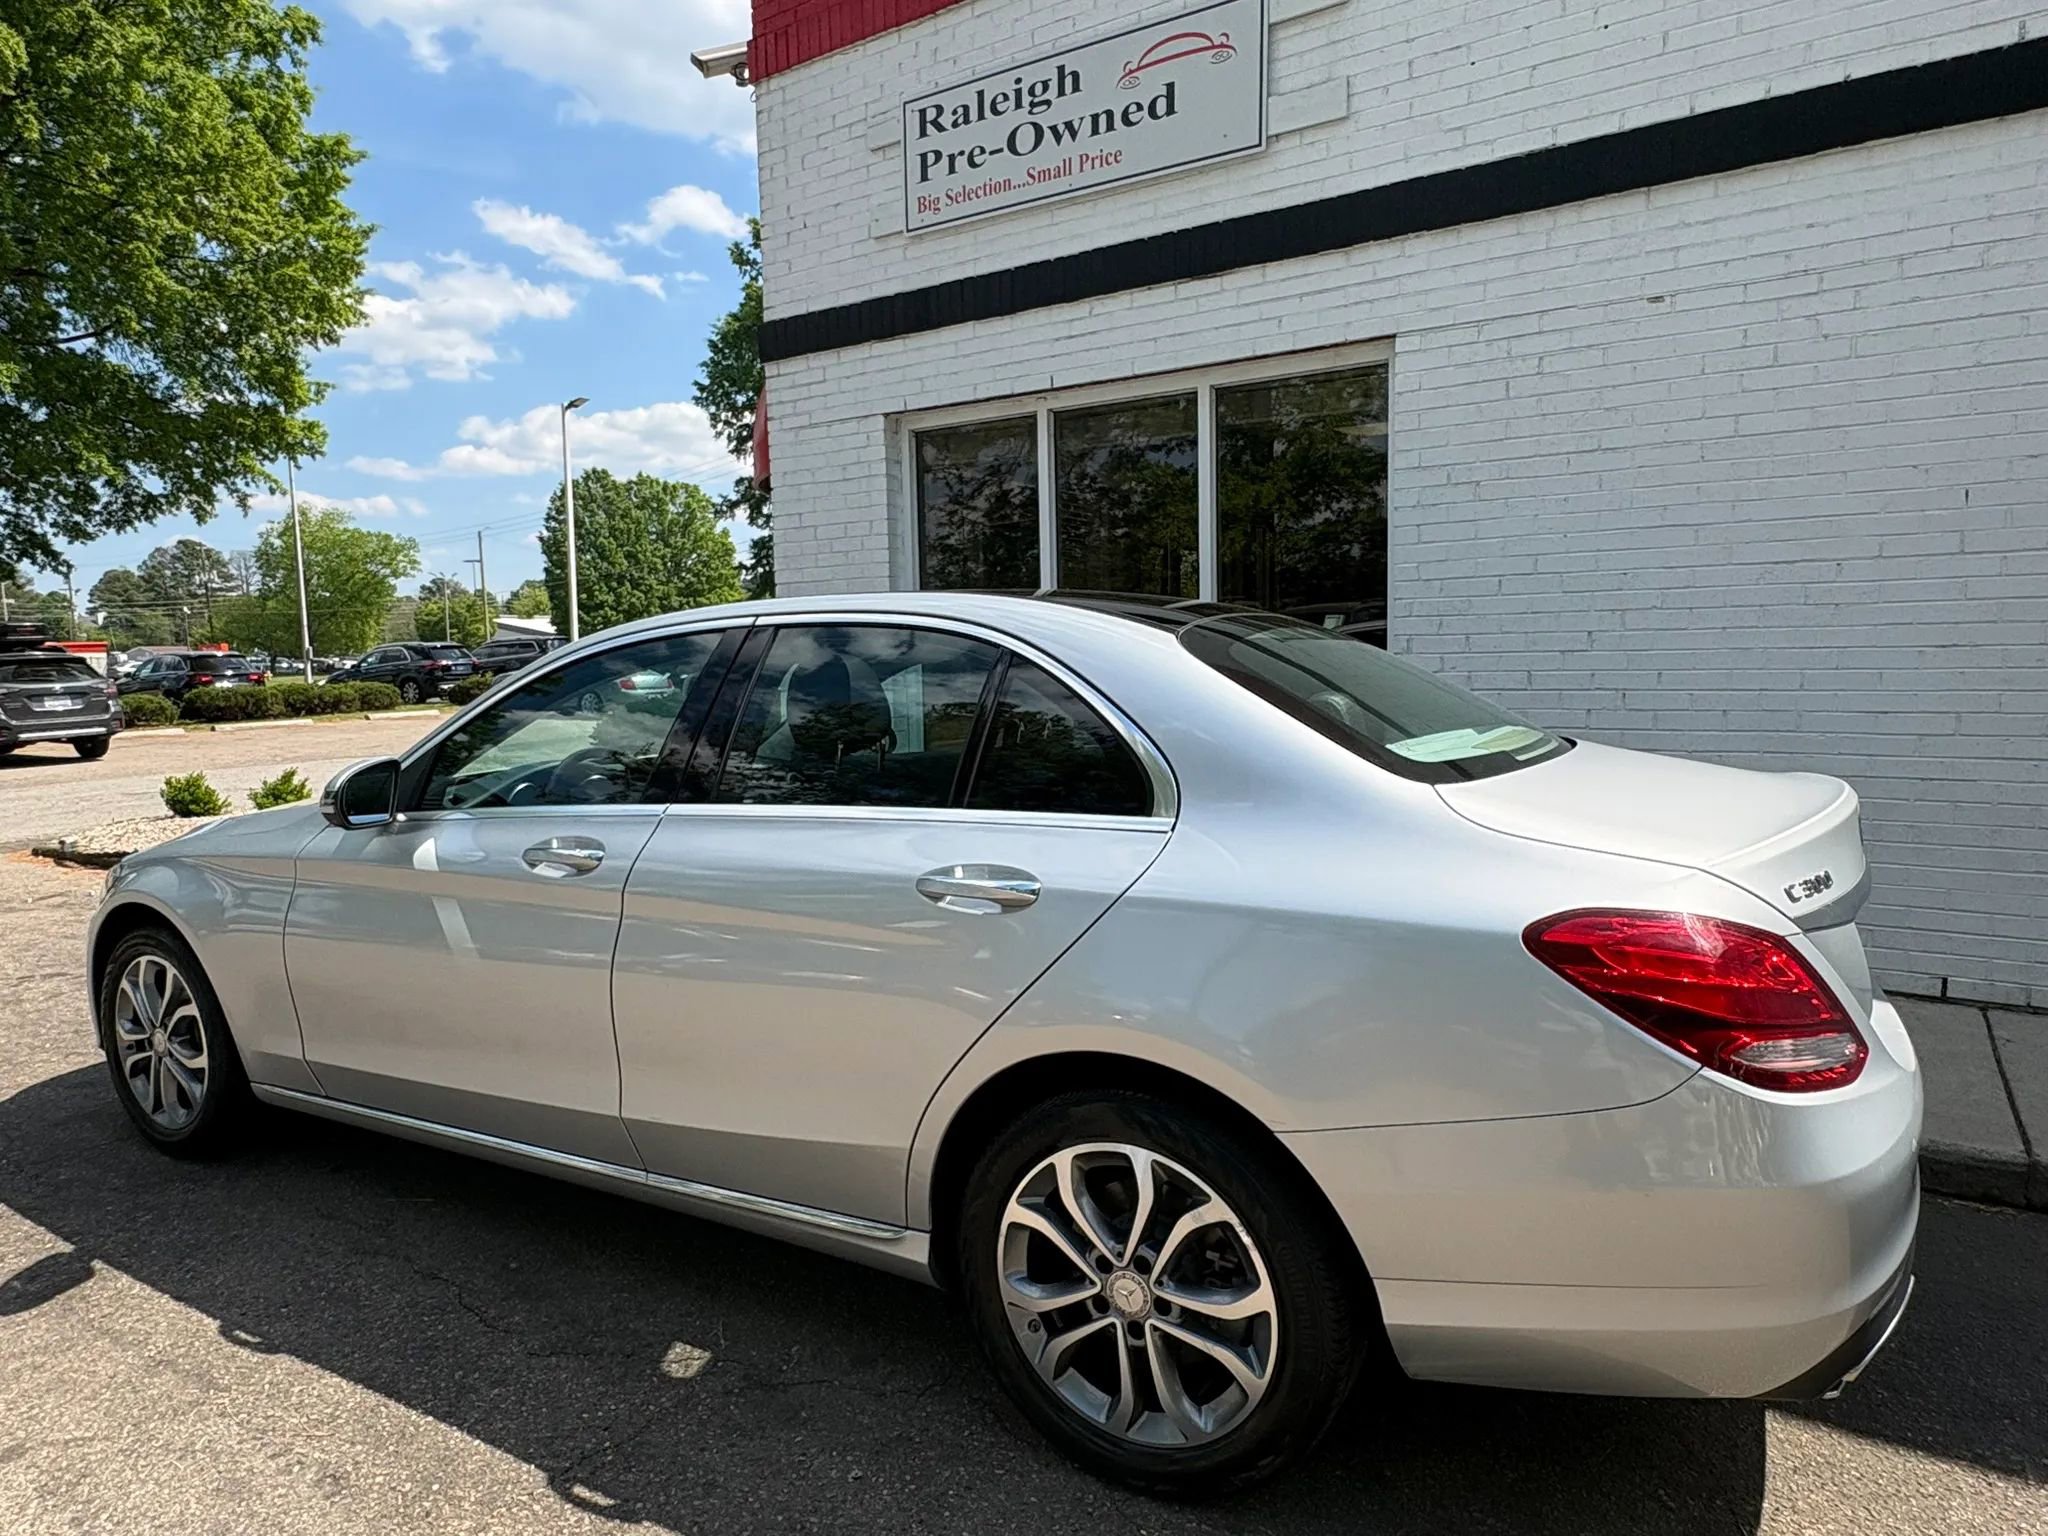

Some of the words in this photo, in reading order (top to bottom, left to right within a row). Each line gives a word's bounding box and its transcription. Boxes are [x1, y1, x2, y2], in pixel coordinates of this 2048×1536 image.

[915, 64, 1083, 140] Raleigh
[916, 81, 1178, 184] Pre-Owned
[917, 194, 941, 214] Big
[1079, 147, 1123, 174] Price
